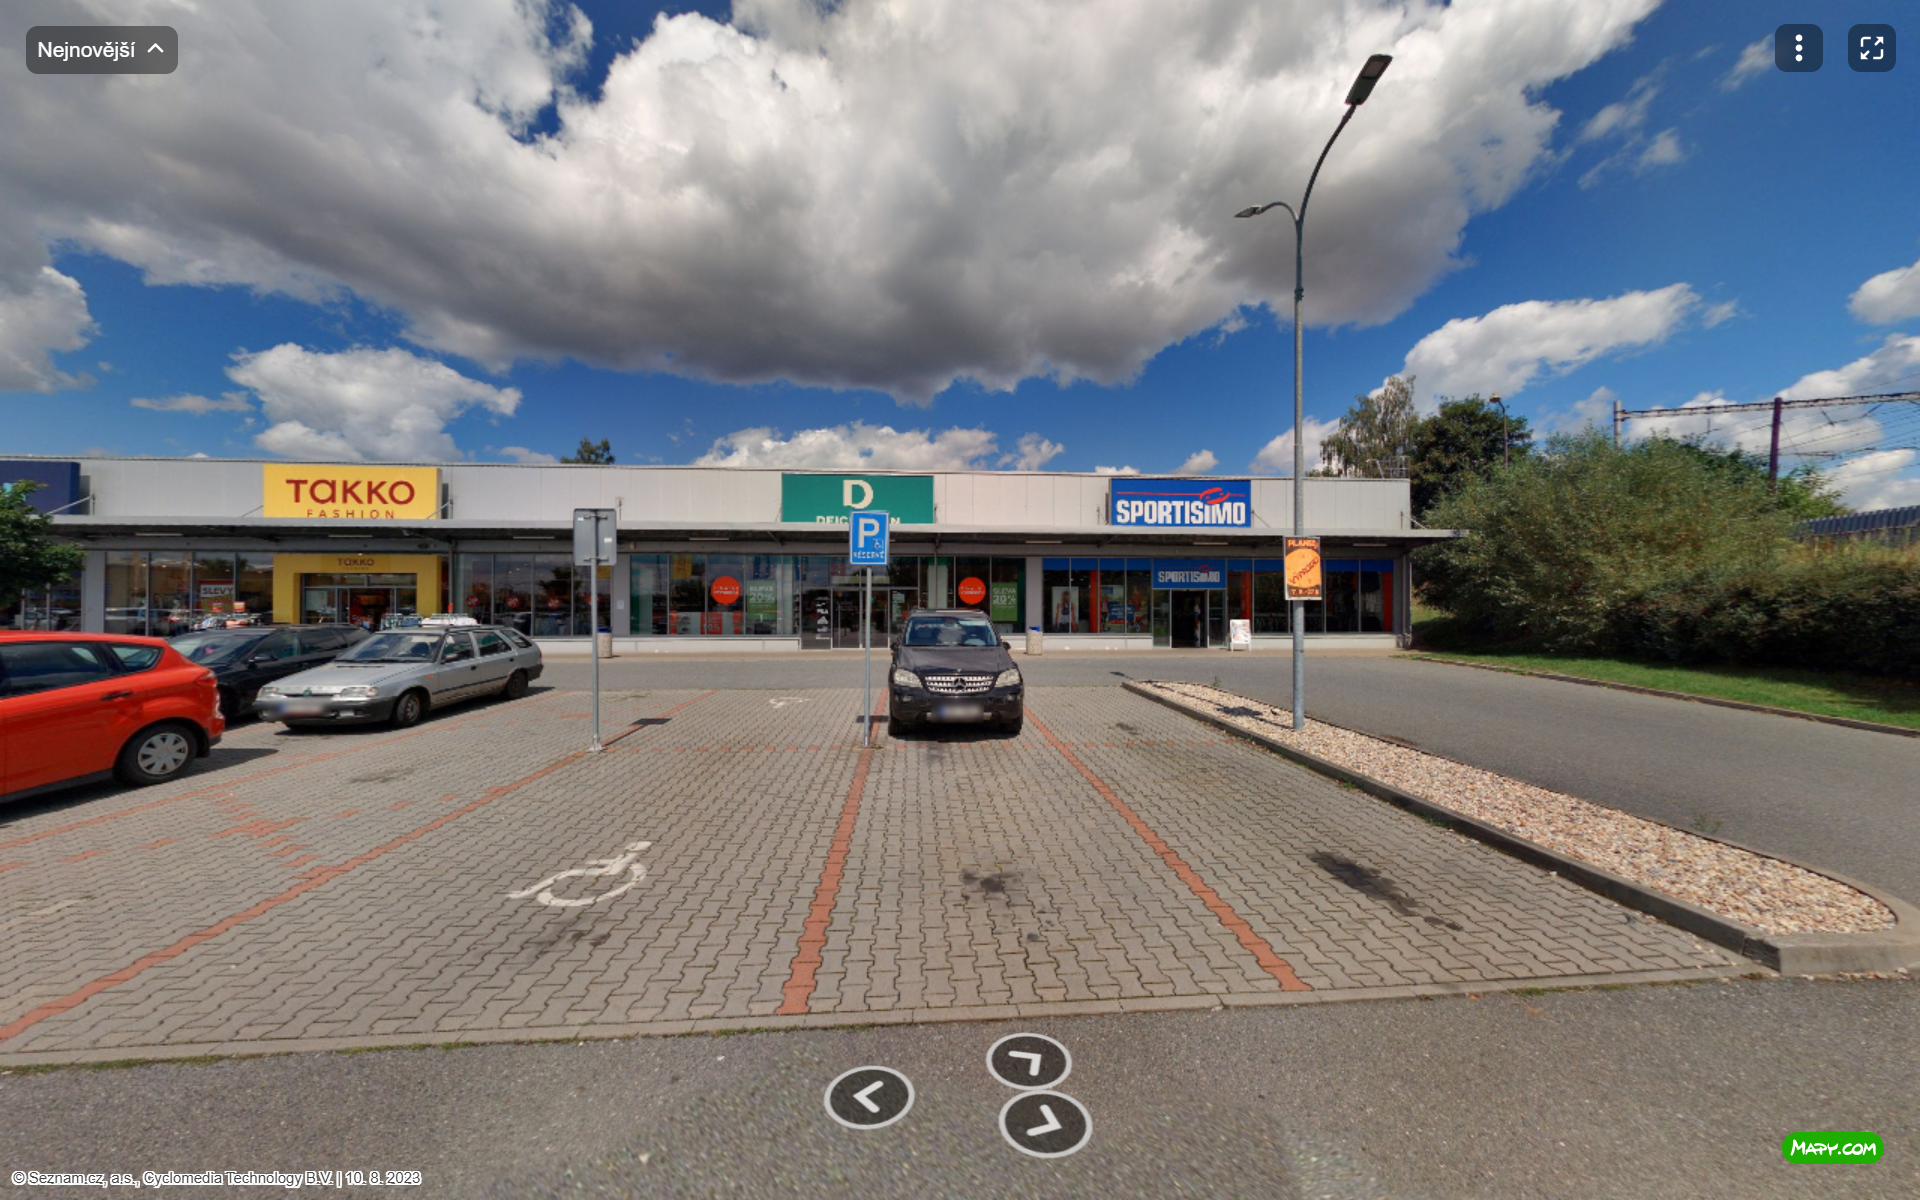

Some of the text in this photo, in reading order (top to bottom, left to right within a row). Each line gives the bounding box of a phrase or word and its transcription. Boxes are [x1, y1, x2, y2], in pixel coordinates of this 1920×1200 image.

[842, 479, 874, 510] D
[306, 509, 395, 519] FASHION
[1115, 499, 1246, 525] SPORTISIMO
[816, 515, 900, 524] DEICN
[857, 517, 880, 548] P
[1157, 570, 1221, 583] SPORTISIMO
[202, 587, 233, 595] SLEVY
